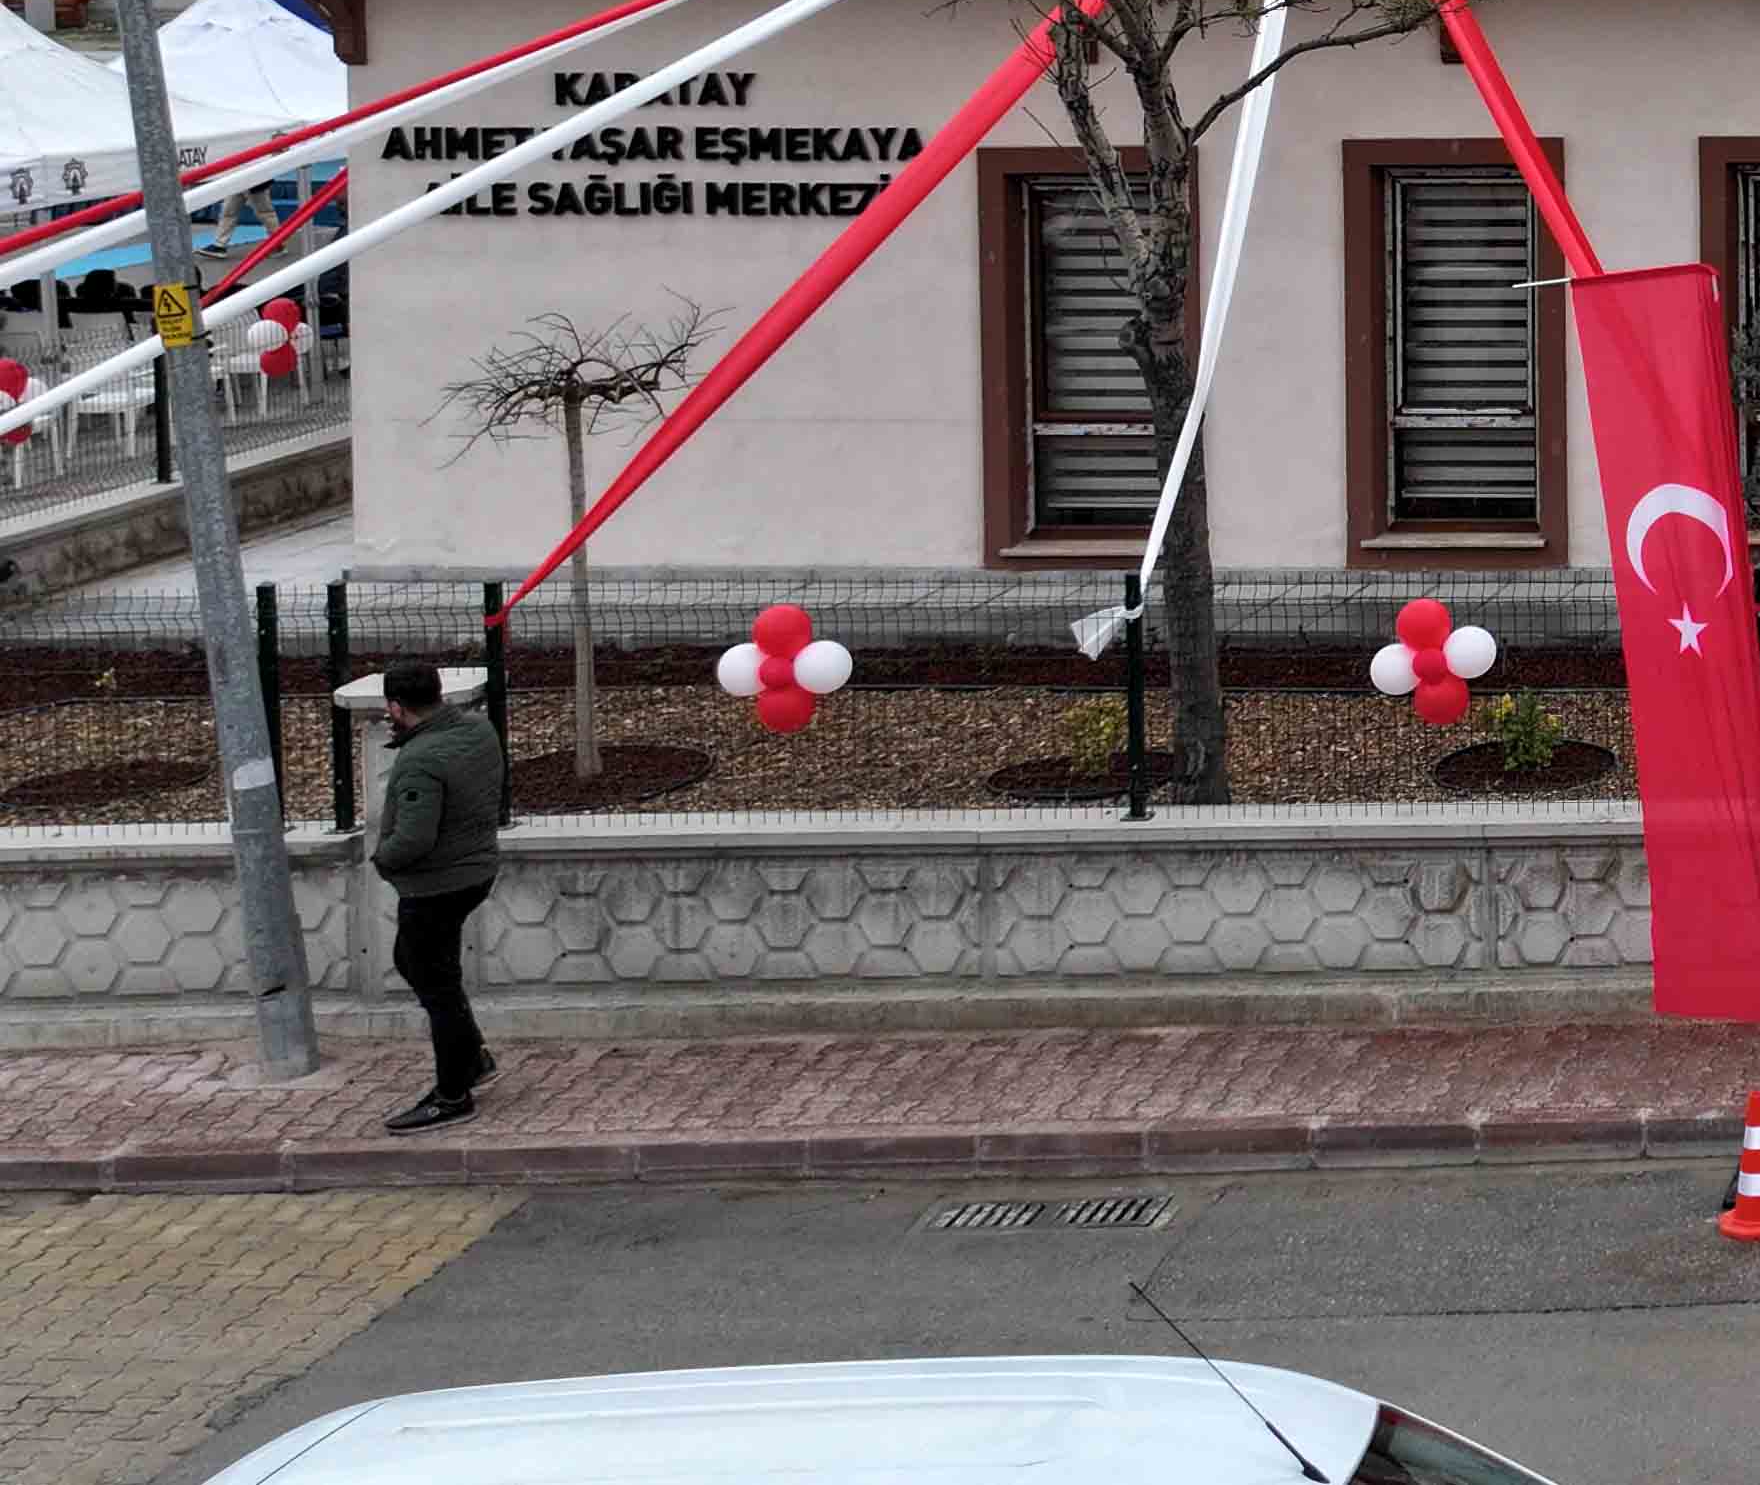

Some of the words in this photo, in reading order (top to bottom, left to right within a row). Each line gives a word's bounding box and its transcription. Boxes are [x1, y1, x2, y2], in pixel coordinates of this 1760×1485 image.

[381, 126, 535, 161] AHMET
[544, 126, 684, 166] AŞAR
[695, 126, 924, 166] EŞMEKAYA
[528, 173, 694, 216] SAĞLIĞI
